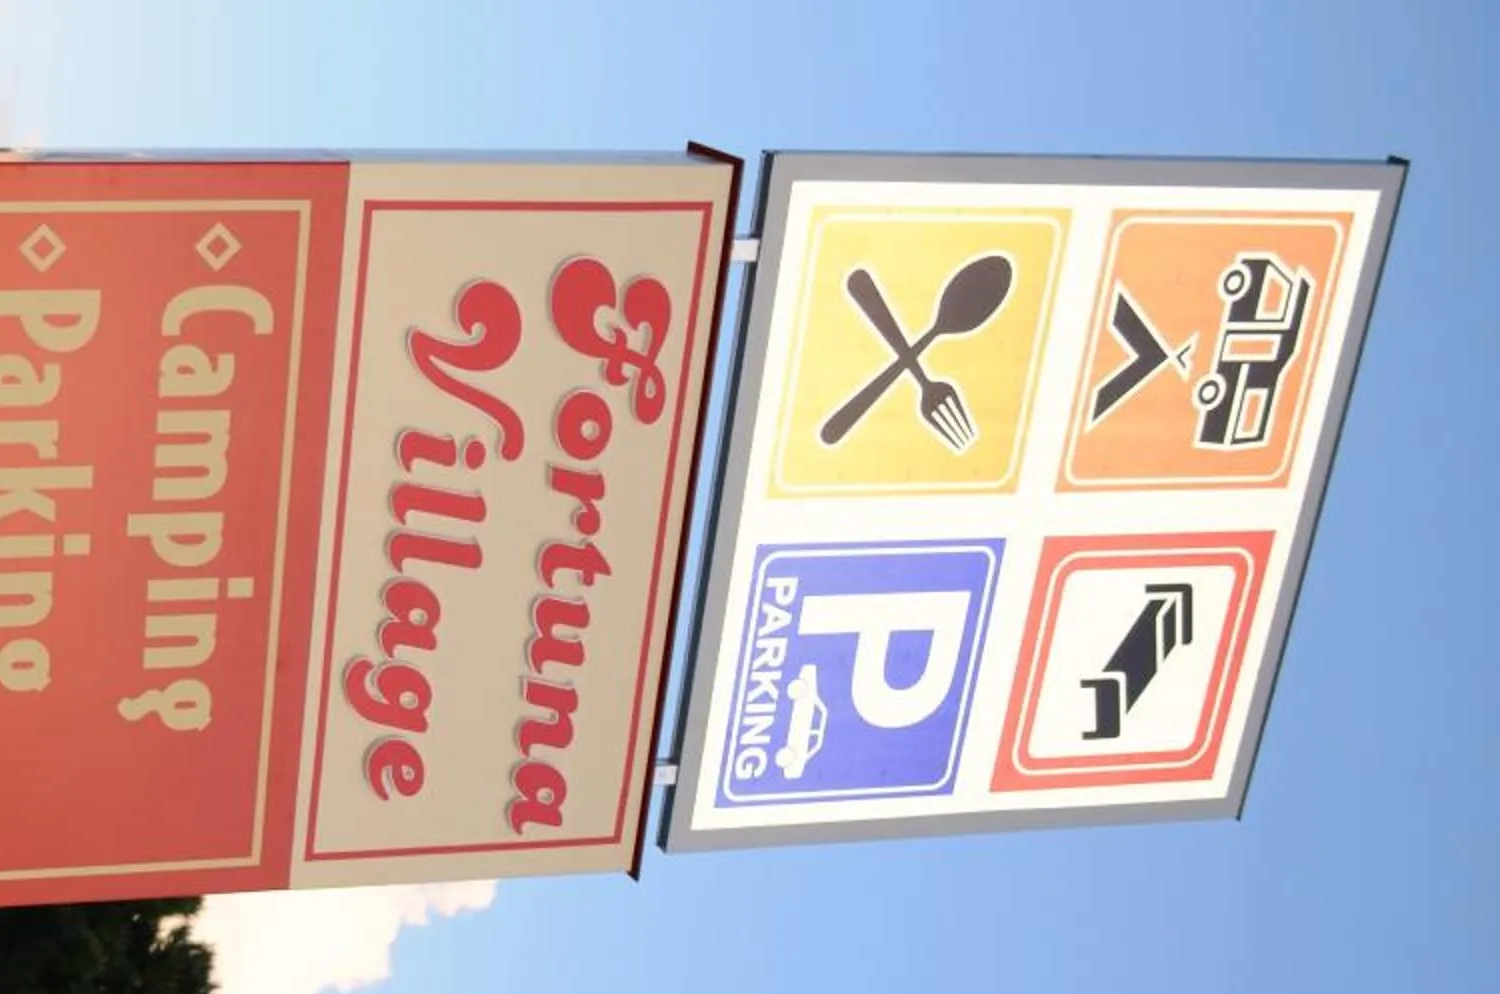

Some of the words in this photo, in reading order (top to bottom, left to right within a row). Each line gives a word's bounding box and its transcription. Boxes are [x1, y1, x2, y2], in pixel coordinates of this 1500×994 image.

[116, 285, 273, 732] Camping
[342, 281, 524, 802] Village
[506, 256, 671, 836] Fortuna
[733, 576, 800, 780] PARKING
[796, 590, 971, 728] P
